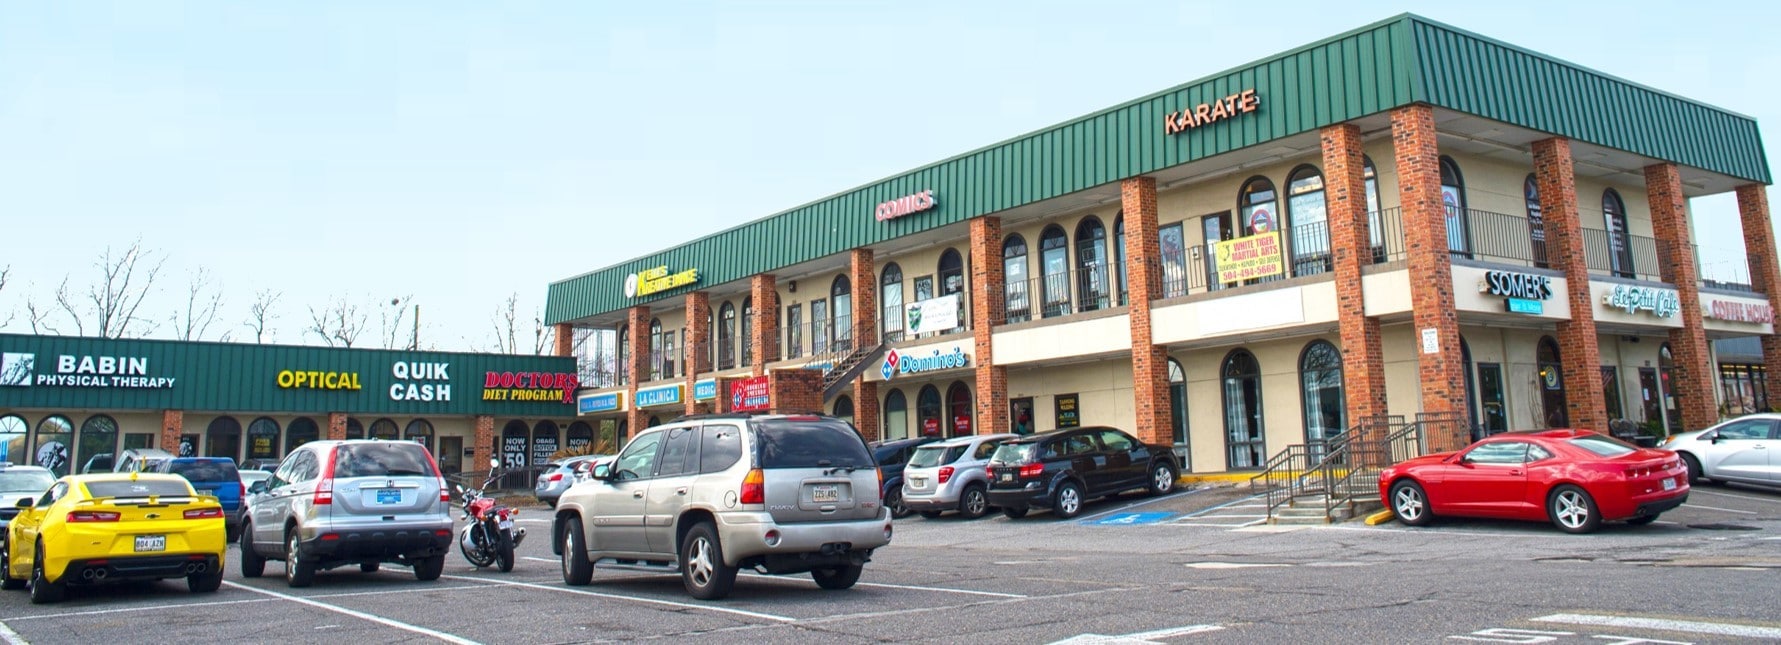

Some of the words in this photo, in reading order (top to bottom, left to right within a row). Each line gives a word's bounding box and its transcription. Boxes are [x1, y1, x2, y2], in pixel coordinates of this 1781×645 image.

[1165, 90, 1257, 133] KARATE
[875, 192, 933, 221] COMICS
[1233, 240, 1254, 251] WHITE
[1255, 236, 1275, 247] TIGER
[1232, 249, 1260, 261] MARTIAL
[1260, 245, 1278, 256] ARTS
[1223, 264, 1277, 281] 504-494-5669
[1487, 271, 1553, 300] SOMER'S
[1613, 284, 1628, 307] Le
[1711, 300, 1744, 322] COFFEE
[1745, 303, 1775, 325] HOUSE
[57, 354, 148, 375] BABIN
[900, 348, 966, 373] Domino's
[276, 369, 361, 390] OPTICAL
[392, 361, 449, 380] QUIK
[37, 374, 109, 387] PHYSICAL
[111, 377, 176, 388] THERAPY
[484, 371, 578, 389] DOCTORS
[389, 383, 451, 401] CASH
[483, 389, 509, 400] DIET
[510, 389, 563, 401] PROGRAM
[639, 393, 648, 405] LA
[648, 389, 675, 404] CLINICA
[697, 385, 716, 396] MEDIC
[504, 444, 526, 452] ONLY
[505, 437, 525, 445] NOW
[569, 438, 589, 446] NOW
